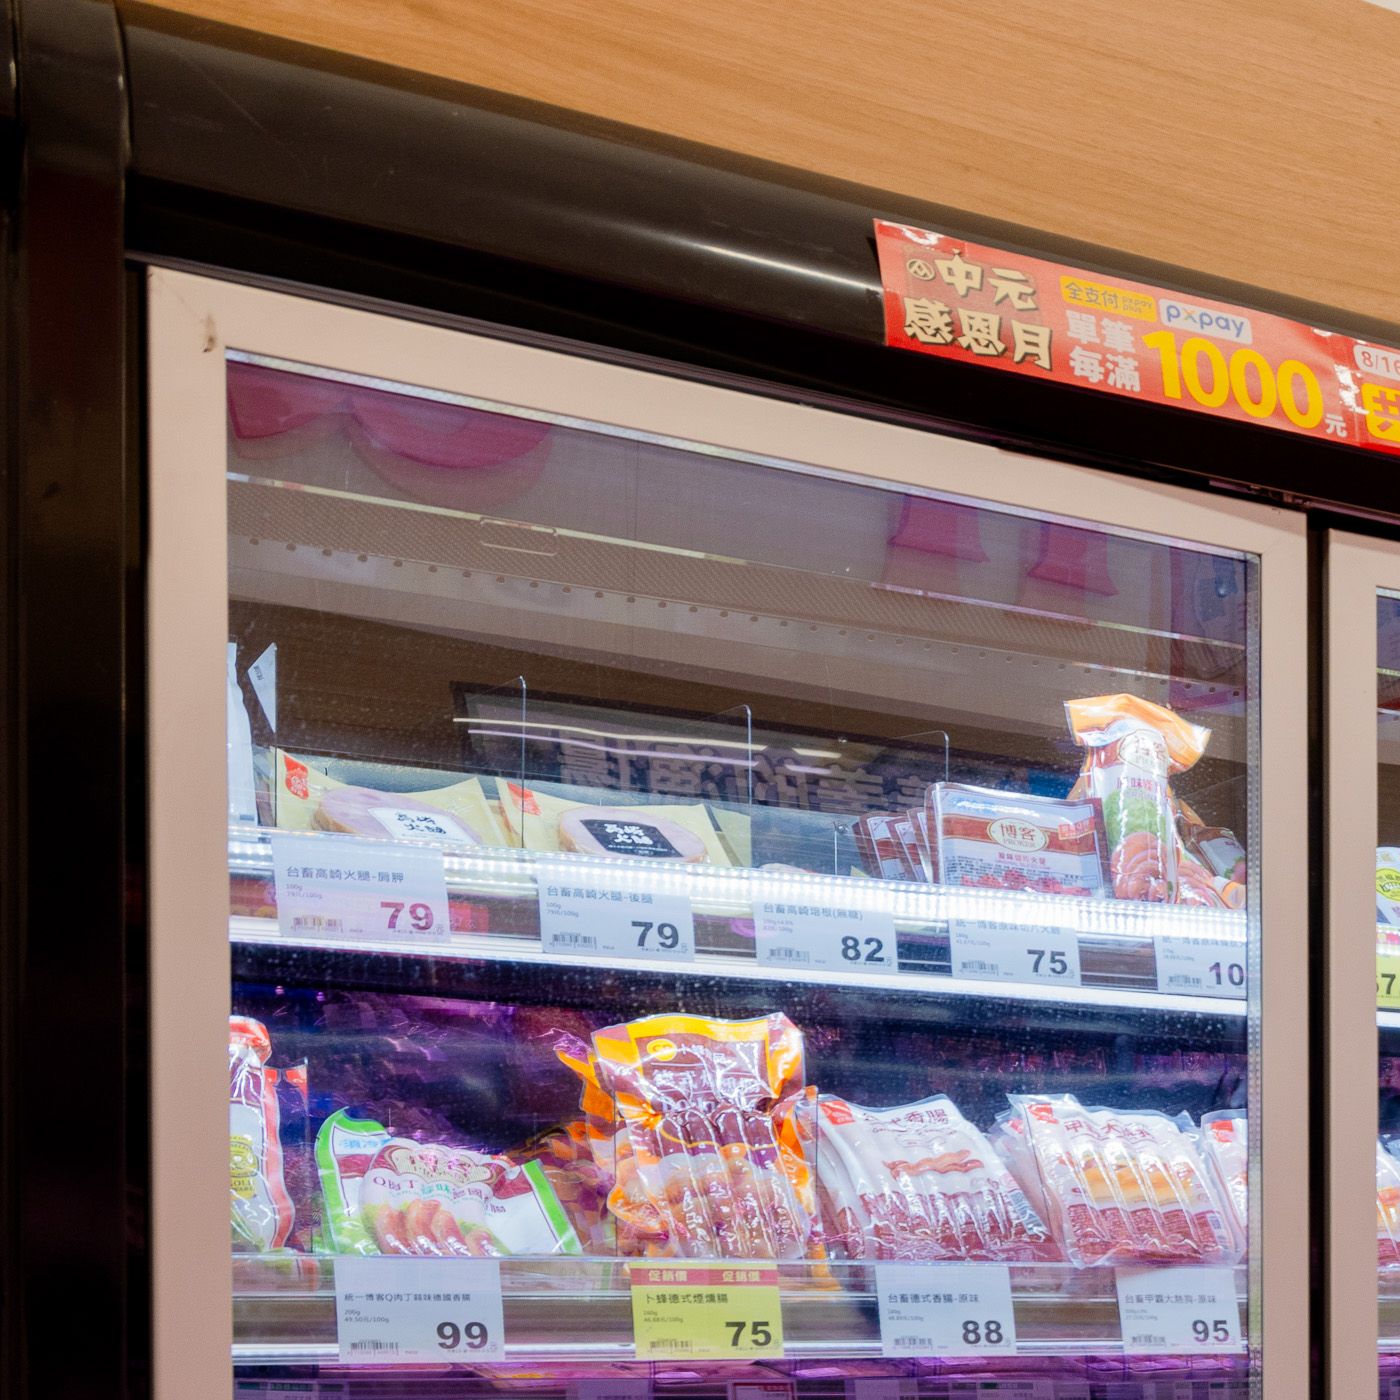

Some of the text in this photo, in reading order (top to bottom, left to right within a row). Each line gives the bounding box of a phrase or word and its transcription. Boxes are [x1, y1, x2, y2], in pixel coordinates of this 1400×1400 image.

[934, 251, 1037, 311] 中元
[1066, 282, 1118, 309] 全支付
[904, 297, 1052, 369] 感恩月
[1065, 309, 1135, 353] 單筆
[1167, 305, 1243, 337] pxpay
[1070, 346, 1140, 392] 每滿
[1142, 330, 1347, 437] 1000 元
[380, 901, 434, 932] 79
[631, 921, 680, 949] 79
[841, 936, 886, 963] 82
[1027, 949, 1068, 976] 75
[437, 1321, 489, 1350] 99
[725, 1321, 772, 1347] 75
[962, 1320, 1004, 1345] 88
[1191, 1319, 1230, 1343] 95
